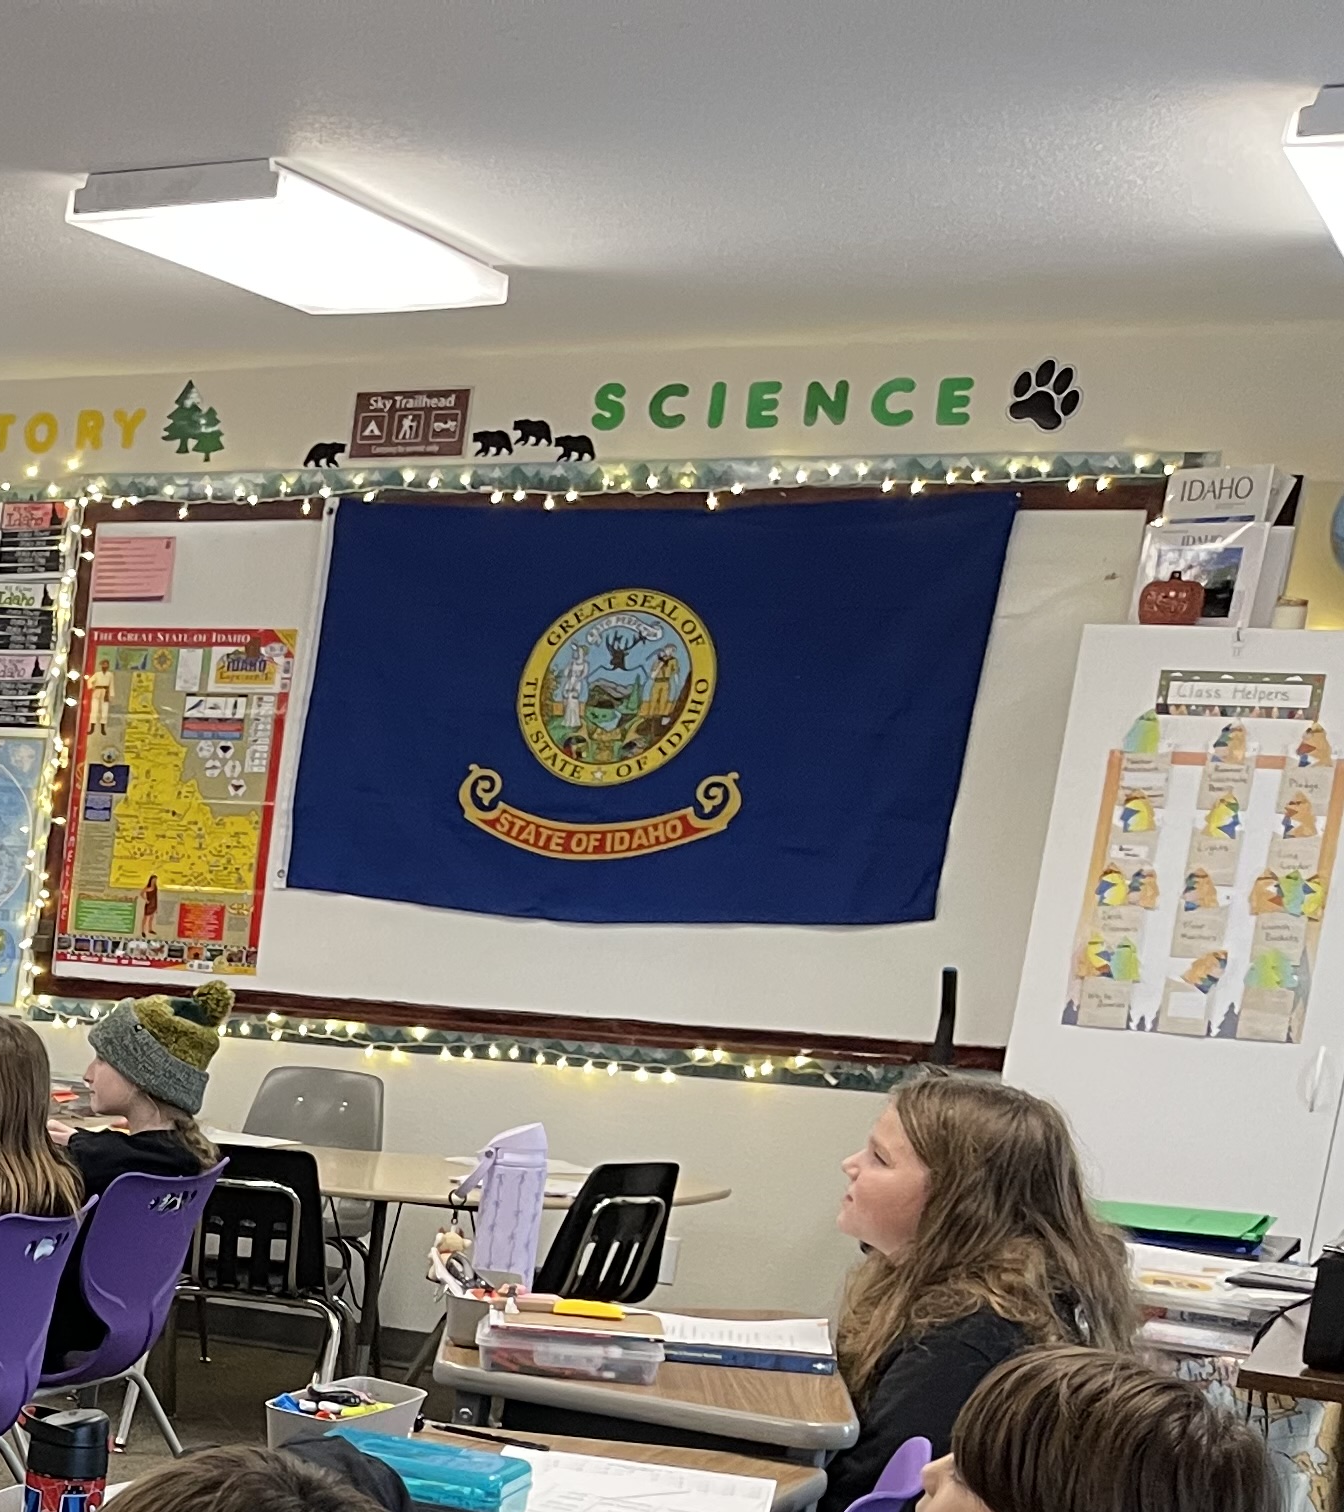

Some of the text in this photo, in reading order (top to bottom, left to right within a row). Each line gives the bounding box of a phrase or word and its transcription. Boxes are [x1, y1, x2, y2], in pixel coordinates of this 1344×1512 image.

[369, 394, 456, 412] Sky Trailhead
[591, 377, 974, 431] SCIENCE
[1180, 476, 1254, 502] IDAHO
[6, 513, 44, 526] Idaho
[546, 594, 708, 647] GREAT SEAL OF
[93, 632, 250, 643] THE GREAT STATE OF IDAHO
[1177, 683, 1290, 702] Class Helpers
[523, 676, 585, 780] THE STATE
[615, 678, 710, 778] OF IDAHO
[495, 812, 683, 853] STATE OF IDAHO
